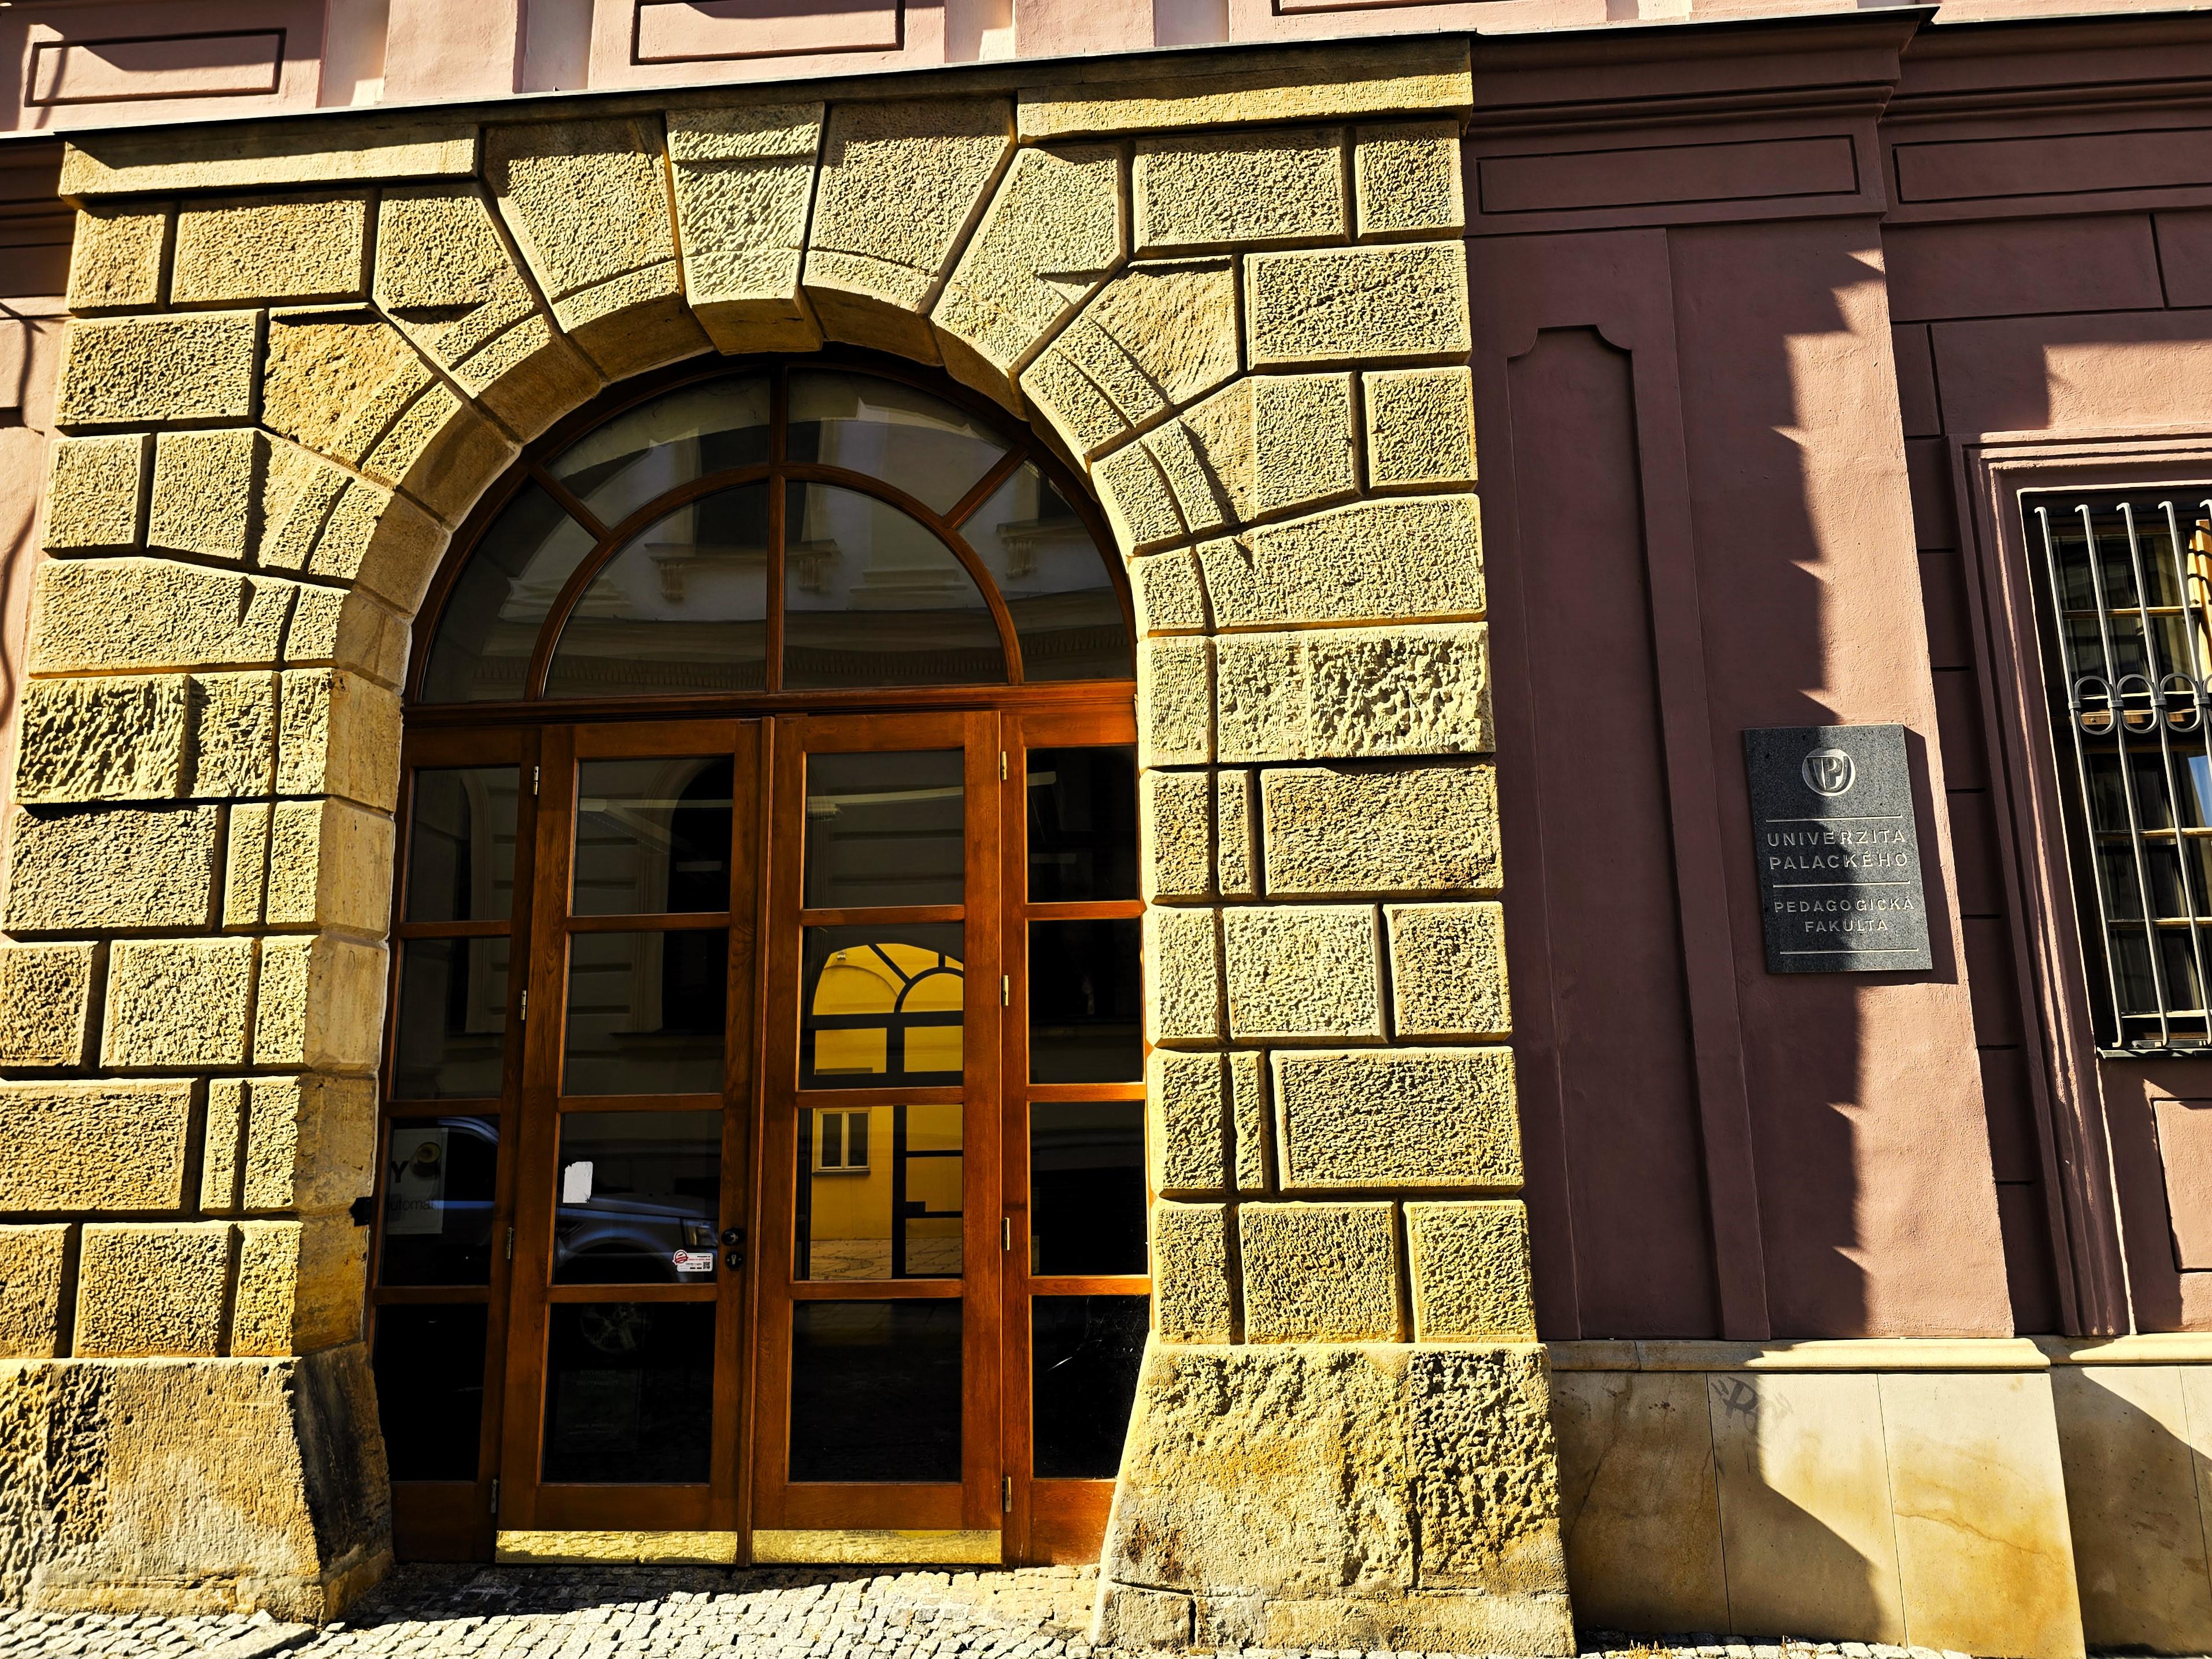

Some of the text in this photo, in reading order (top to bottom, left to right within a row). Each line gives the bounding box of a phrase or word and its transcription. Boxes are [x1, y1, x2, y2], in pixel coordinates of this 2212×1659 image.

[1767, 829, 1906, 847] UNIVERZITA
[1769, 851, 1907, 870] PALACKÉHO
[1774, 895, 1914, 912] PEDAGOGICKÁ
[1804, 919, 1888, 933] FAKULTA
